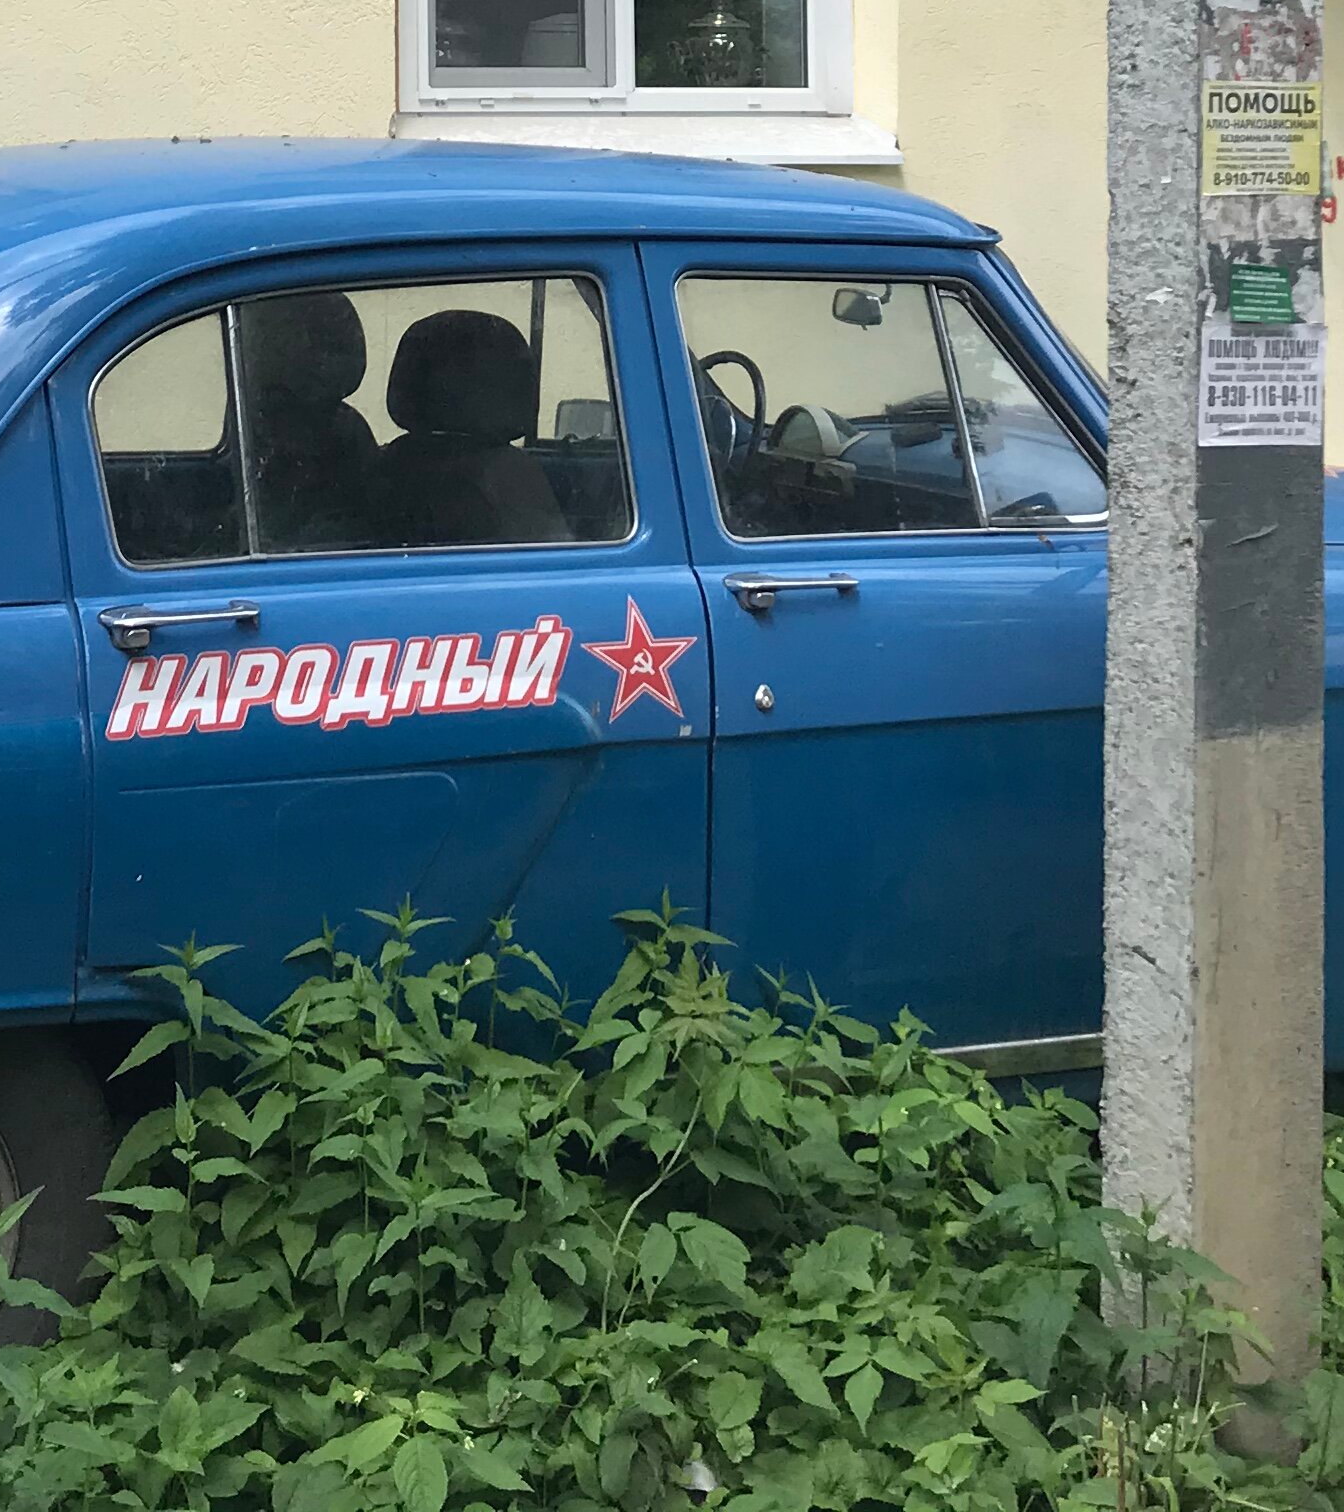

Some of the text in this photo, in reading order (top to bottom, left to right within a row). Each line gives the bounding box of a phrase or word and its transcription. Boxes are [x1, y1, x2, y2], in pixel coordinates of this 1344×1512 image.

[1208, 92, 1316, 117] ПОМОЩЬ
[1213, 172, 1310, 186] 8-910-774-50-00
[1208, 339, 1257, 360] ПОМОЩЬ
[106, 615, 574, 740] НАРОДНЫЙ
